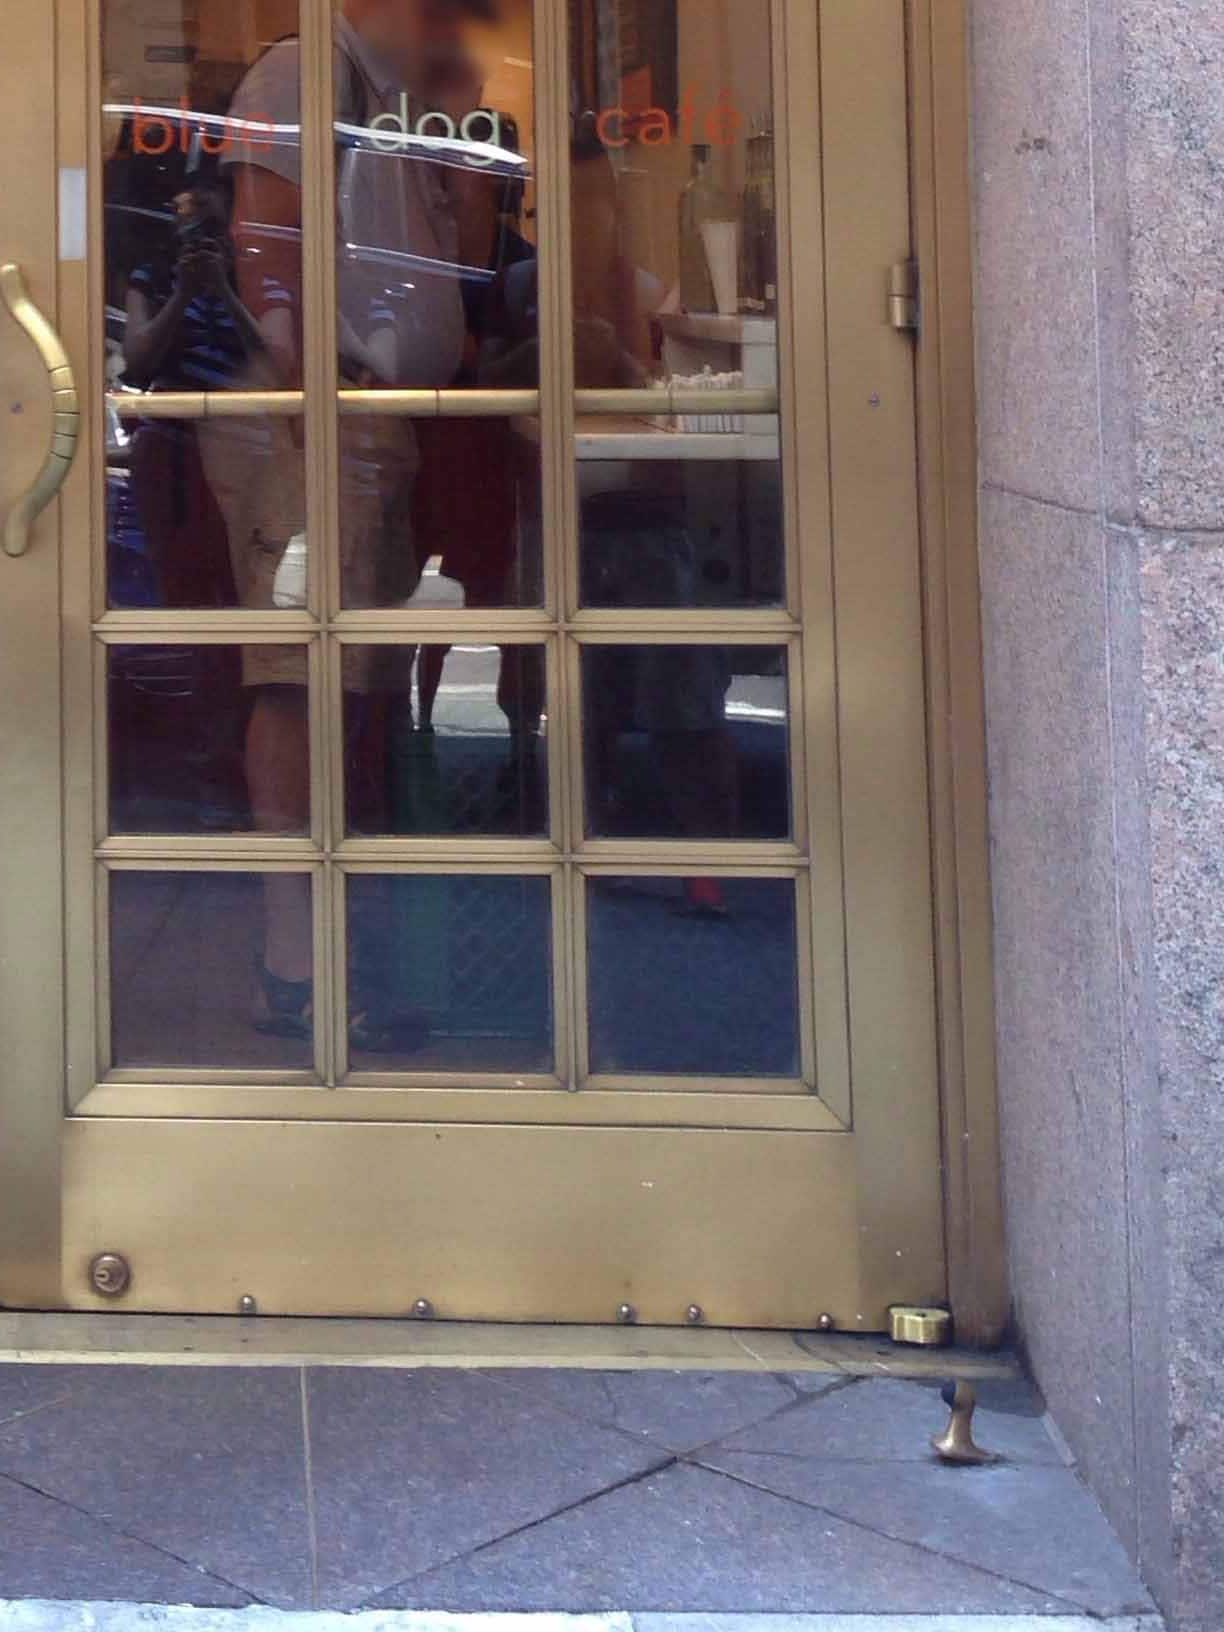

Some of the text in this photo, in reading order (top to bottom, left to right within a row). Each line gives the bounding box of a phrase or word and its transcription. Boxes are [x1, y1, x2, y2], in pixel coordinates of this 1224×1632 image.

[132, 81, 743, 167] blue dog café
